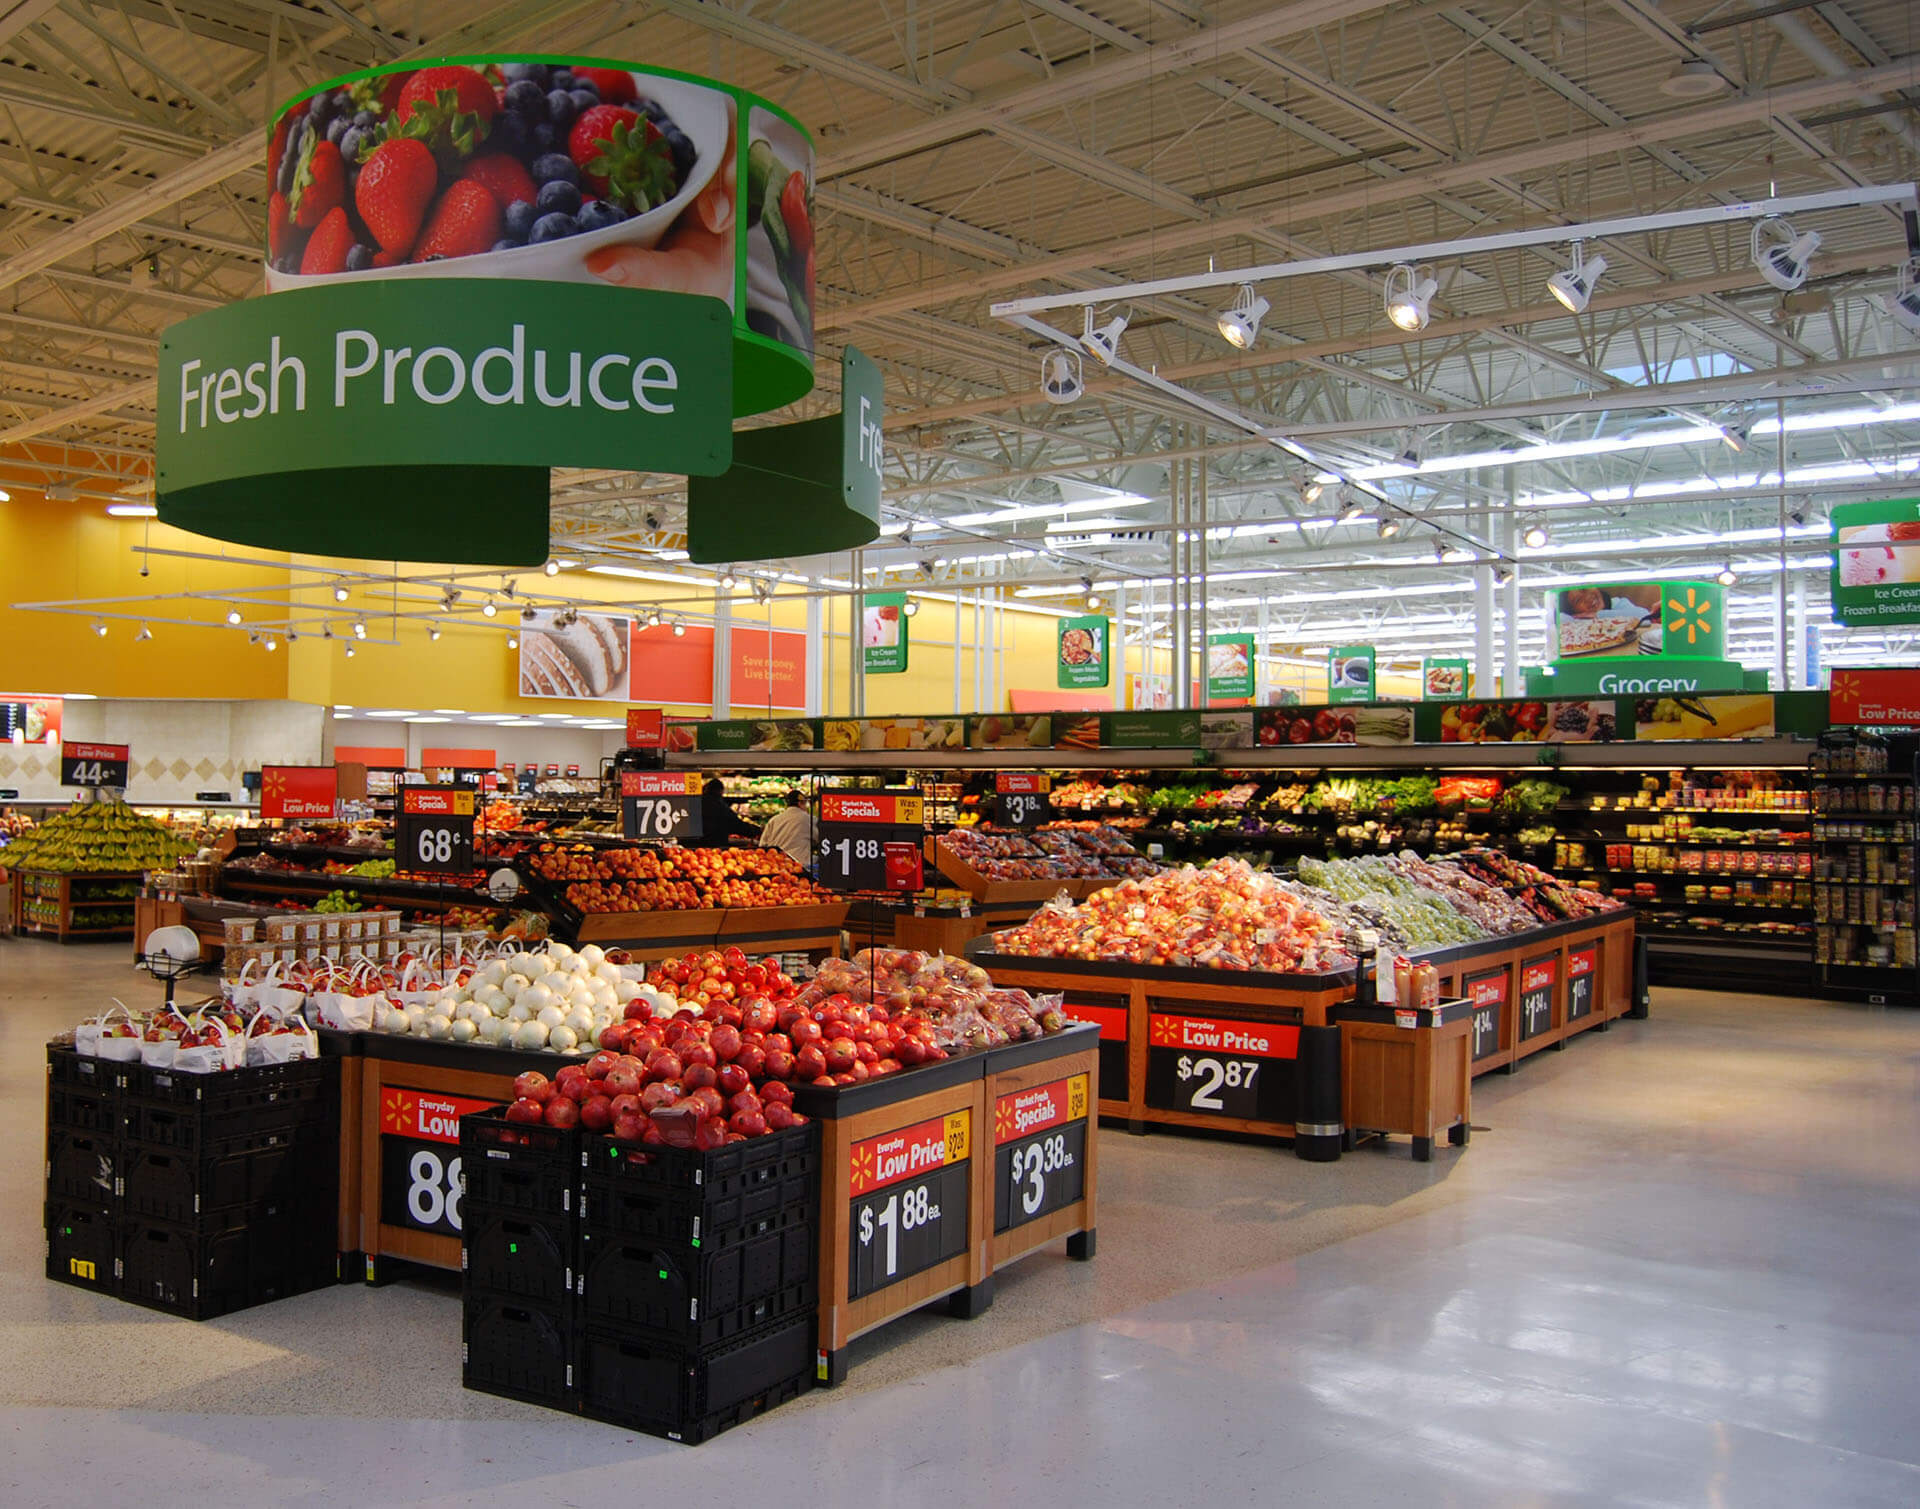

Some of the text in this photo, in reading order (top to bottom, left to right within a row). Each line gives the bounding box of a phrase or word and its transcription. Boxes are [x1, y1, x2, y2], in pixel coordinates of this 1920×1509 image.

[180, 324, 679, 434] Fresh Produce
[1874, 589, 1890, 599] Ice
[1843, 605, 1877, 616] Frozen
[743, 656, 763, 667] Save
[744, 667, 763, 679] Live
[1598, 674, 1698, 694] Grocery
[1859, 707, 1920, 720] Low Price
[716, 728, 745, 738] Produce
[77, 747, 116, 759] Low Price
[640, 780, 660, 792] Low
[662, 780, 686, 792] Price
[282, 802, 330, 813] Low Price
[418, 799, 448, 811] Specials
[841, 806, 881, 818] Specials
[1184, 1020, 1216, 1031] Everyday
[1183, 1028, 1269, 1052] Low Price
[419, 1098, 456, 1115] Everyday
[1015, 1099, 1056, 1133] Specials
[418, 1108, 460, 1138] Low
[876, 1137, 905, 1155] Everyday
[876, 1153, 909, 1181] Low
[910, 1138, 945, 1170] Price
